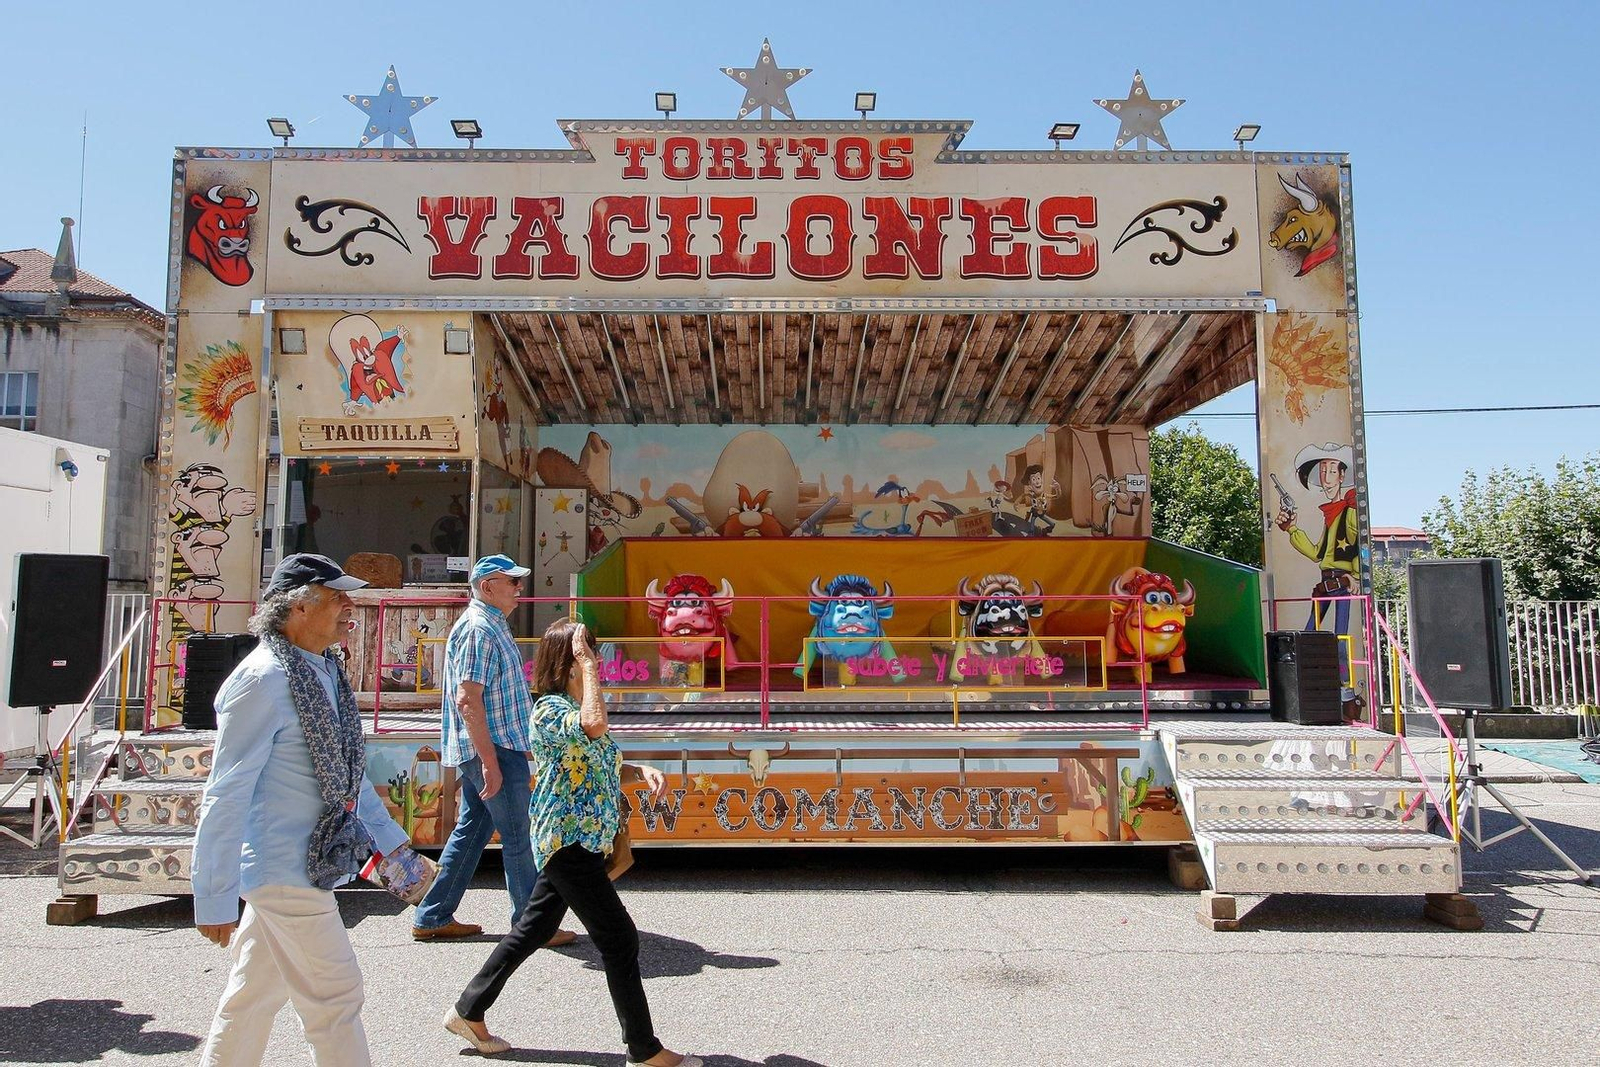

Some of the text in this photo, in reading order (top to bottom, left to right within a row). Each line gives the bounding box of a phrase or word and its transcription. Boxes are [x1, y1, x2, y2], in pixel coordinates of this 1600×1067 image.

[614, 136, 914, 180] TORITOS
[417, 194, 1098, 281] VACILONES
[321, 424, 433, 442] TAQUILLA
[846, 648, 922, 677] subete
[713, 786, 1040, 832] COMANCHE
